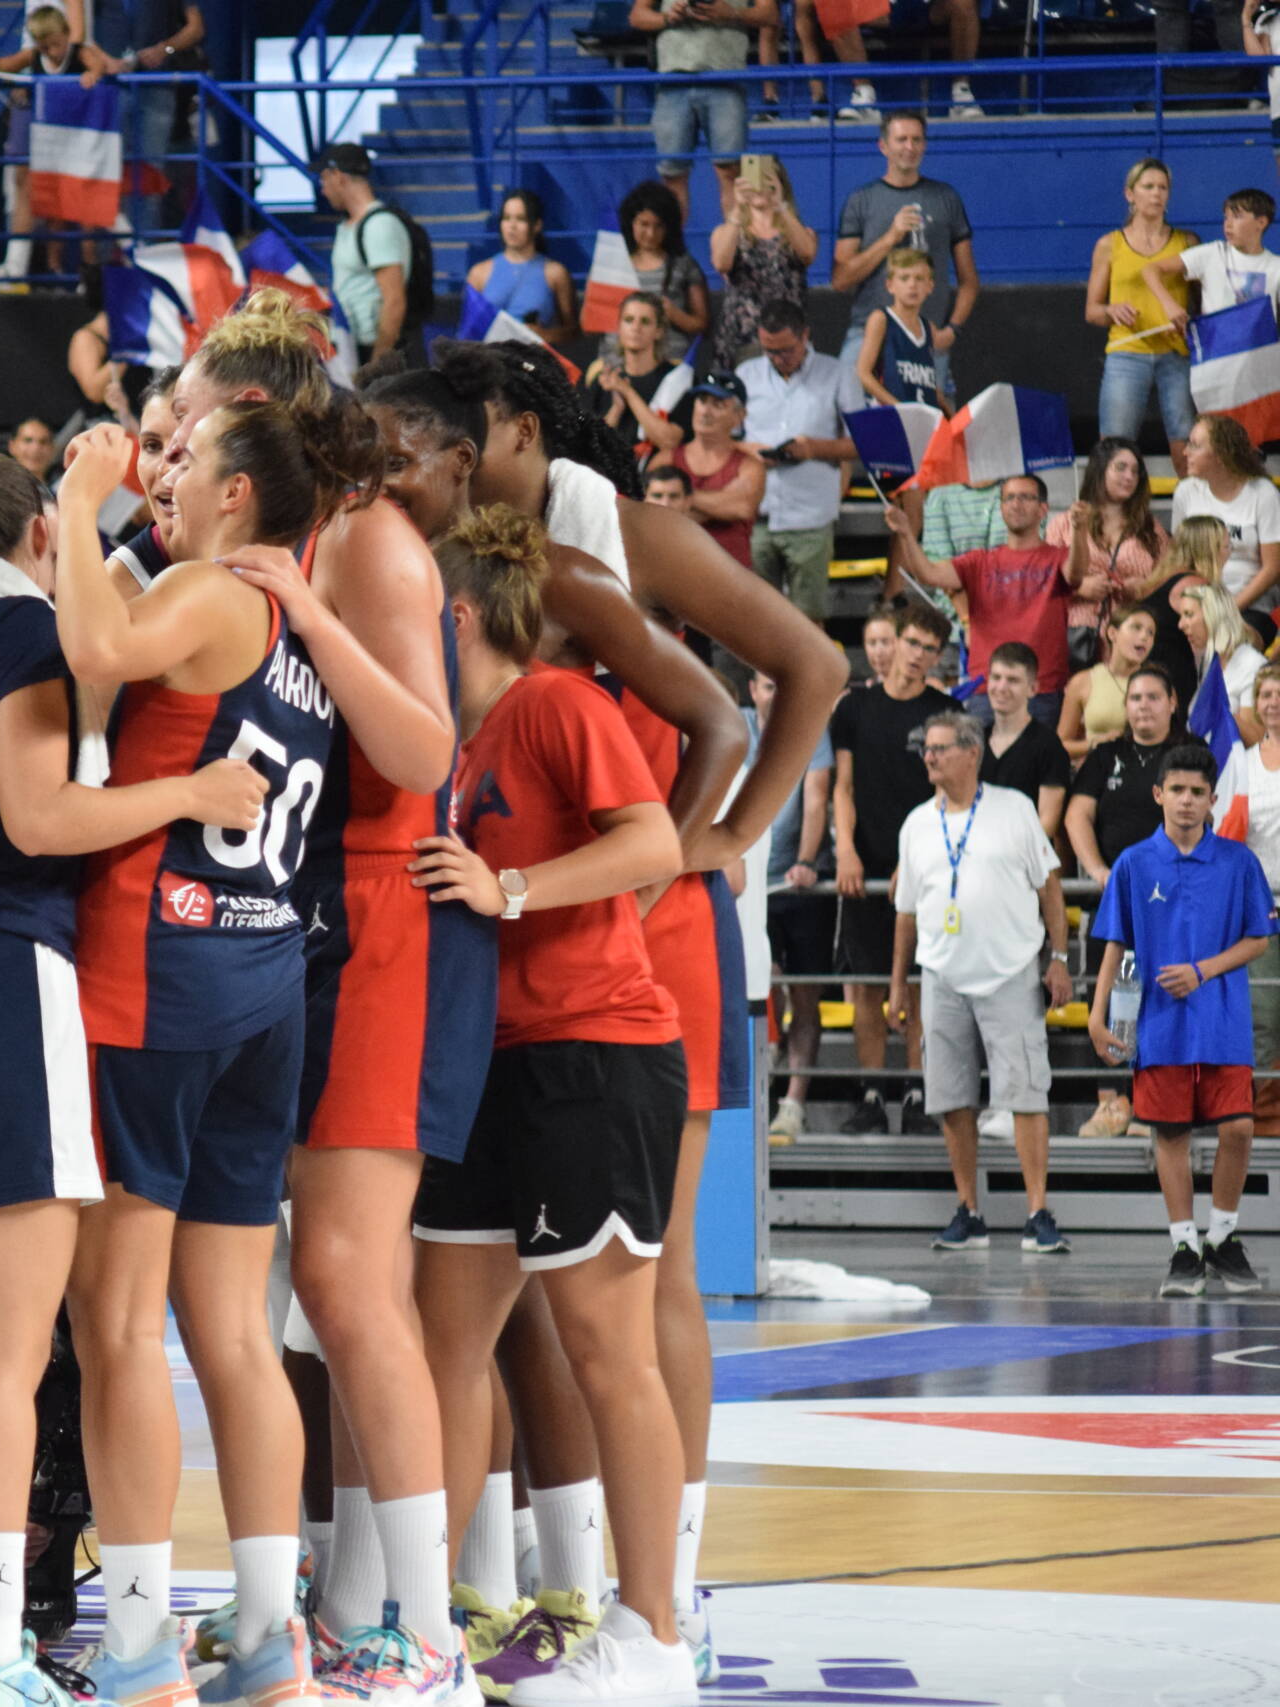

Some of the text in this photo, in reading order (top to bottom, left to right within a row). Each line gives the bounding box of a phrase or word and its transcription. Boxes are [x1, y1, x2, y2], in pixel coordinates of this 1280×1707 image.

[896, 360, 936, 390] FRANC
[264, 639, 336, 729] PARDO
[202, 719, 324, 887] 50
